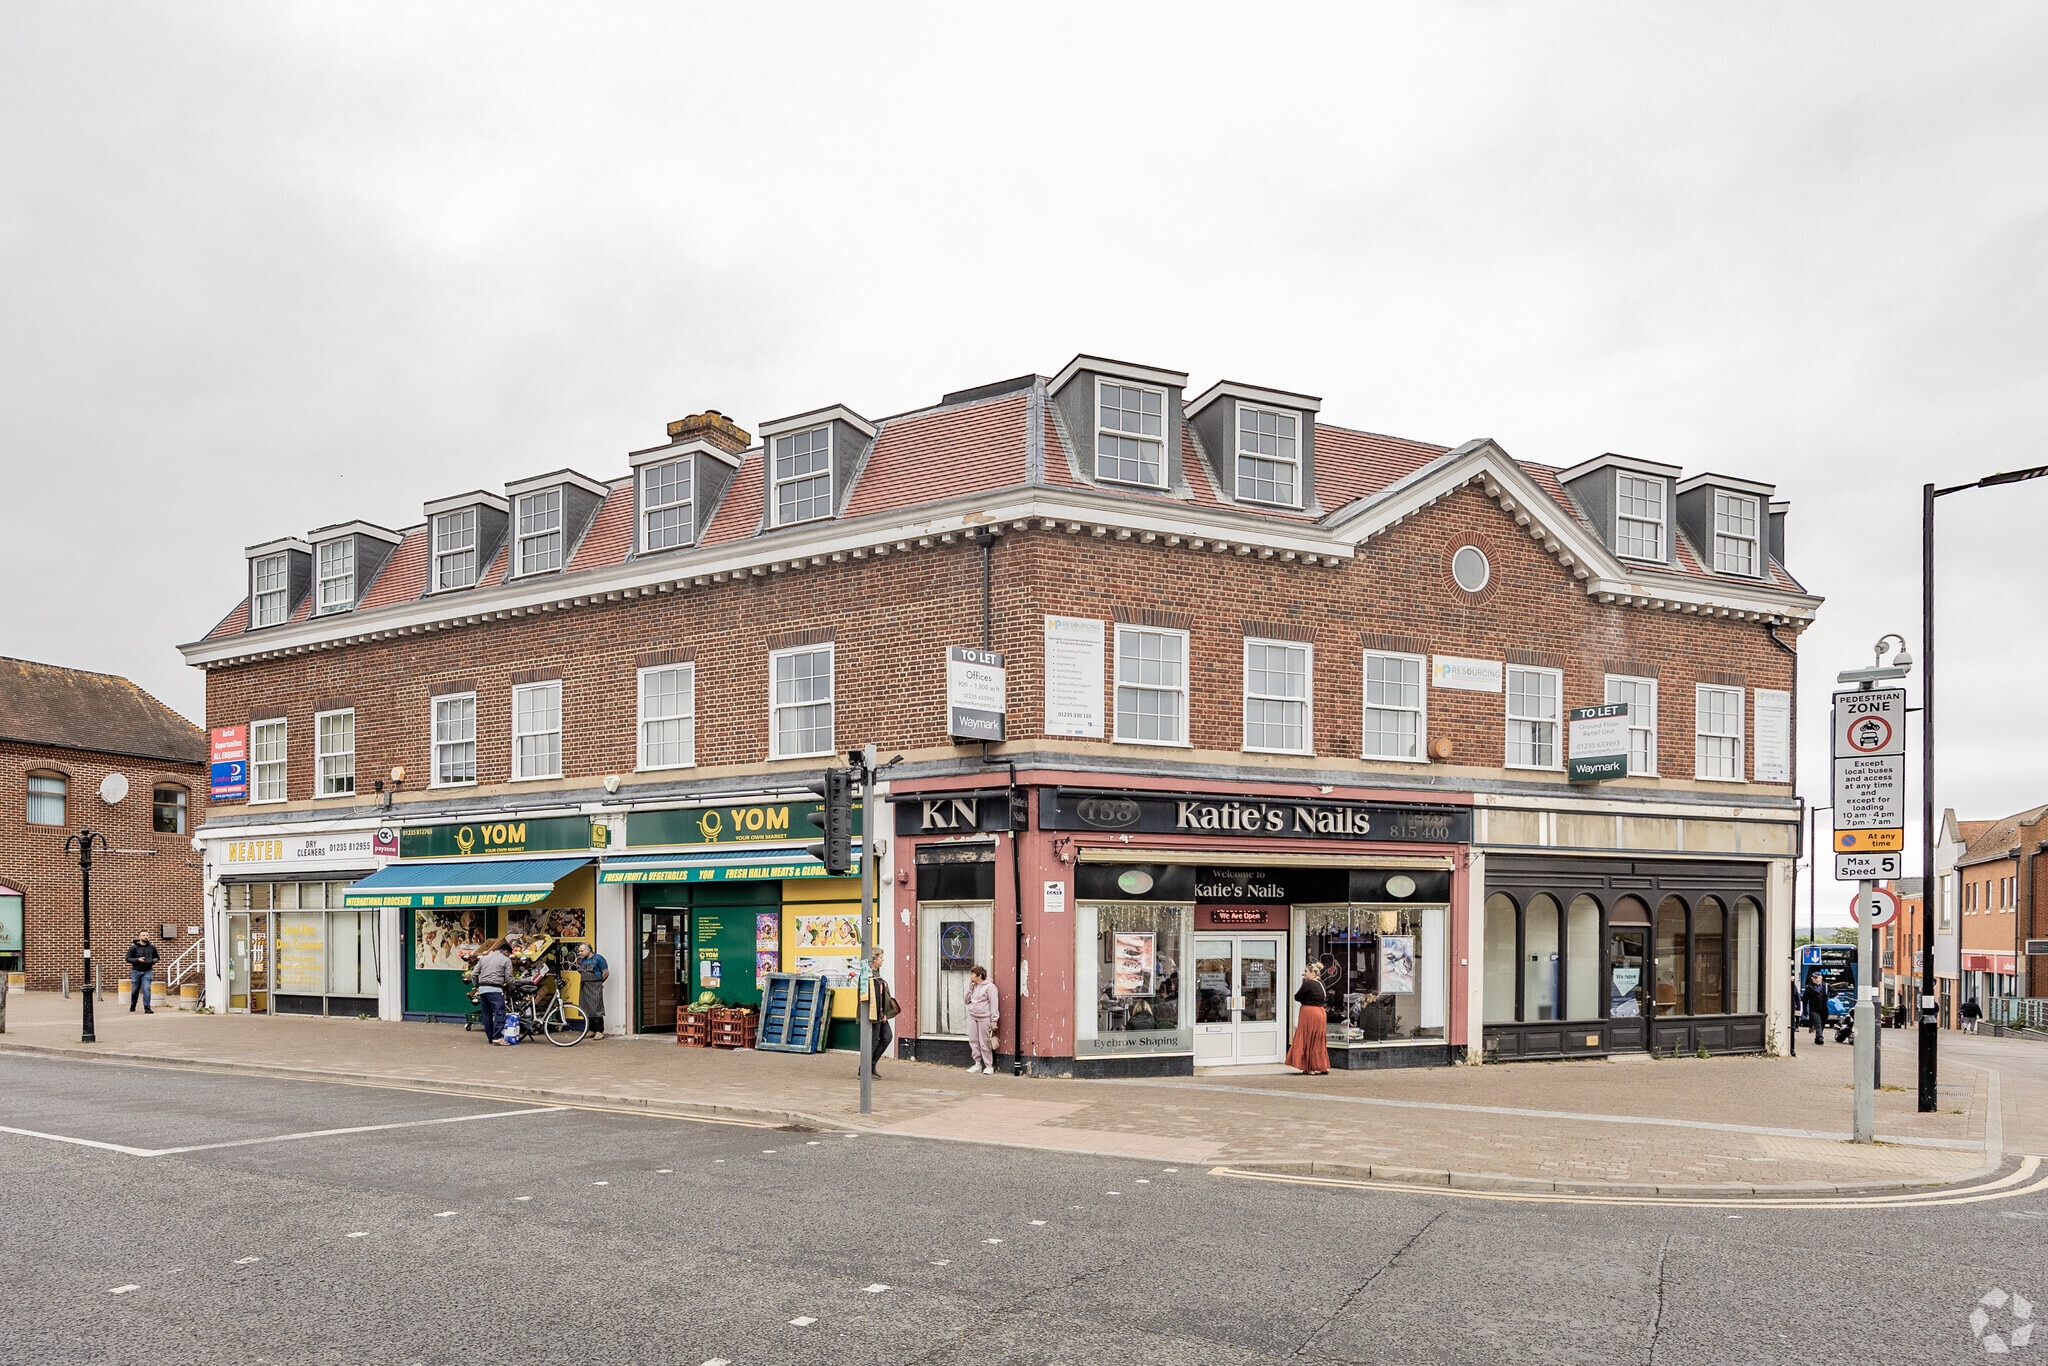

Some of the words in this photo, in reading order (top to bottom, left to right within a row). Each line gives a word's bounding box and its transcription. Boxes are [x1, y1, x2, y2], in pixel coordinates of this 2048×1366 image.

[1063, 621, 1100, 630] RESOURCING
[961, 649, 976, 661] TO
[980, 652, 996, 664] LET
[966, 670, 992, 682] Offices
[1452, 666, 1500, 679] RESOURCING
[1840, 693, 1900, 703] PEDESTRIAN
[1580, 708, 1595, 718] TO
[1598, 706, 1618, 716] LET
[1848, 702, 1890, 713] ZONE
[959, 716, 999, 730] Waymark
[215, 740, 242, 750] Opportunities
[222, 750, 244, 759] ENQUIRIES
[1576, 761, 1620, 774] Waymark
[731, 807, 789, 831] YOM
[921, 798, 979, 829] KN
[1013, 812, 1027, 822] Nails
[1176, 801, 1284, 831] Katie's
[1292, 806, 1370, 834] Nails
[481, 823, 526, 845] YOM
[1390, 825, 1417, 838] 815
[1422, 826, 1449, 839] 400
[228, 840, 282, 861] NEATER
[297, 848, 325, 857] CLEANERS
[330, 843, 346, 852] 01235
[348, 842, 370, 850] 812955
[1882, 858, 1894, 872] 5
[604, 873, 624, 882] FRESH
[624, 872, 644, 881] FRUIT
[642, 872, 648, 880] &
[648, 871, 688, 881] VEGETABLES
[699, 870, 715, 880] YOM
[725, 869, 748, 879] FRESH
[748, 868, 769, 878] HALAL
[770, 867, 794, 877] MEATS
[795, 868, 801, 876] &
[802, 866, 828, 876] GLOBA
[1213, 870, 1254, 878] Welcome
[1841, 868, 1876, 876] Speed
[1194, 883, 1242, 897] Katie's
[1247, 884, 1284, 897] Nails
[346, 897, 383, 906] INTERNATIONAL
[383, 896, 412, 906] GROCERIES
[422, 896, 434, 905] YOM
[444, 896, 460, 904] FRESH
[478, 894, 497, 904] MEATS
[502, 894, 524, 903] GLOBAL
[1872, 900, 1882, 916] 5
[867, 917, 872, 925] 3
[942, 956, 971, 967] NAILS
[1094, 1038, 1136, 1050] Eyebrow
[1138, 1036, 1178, 1047] Shaping
